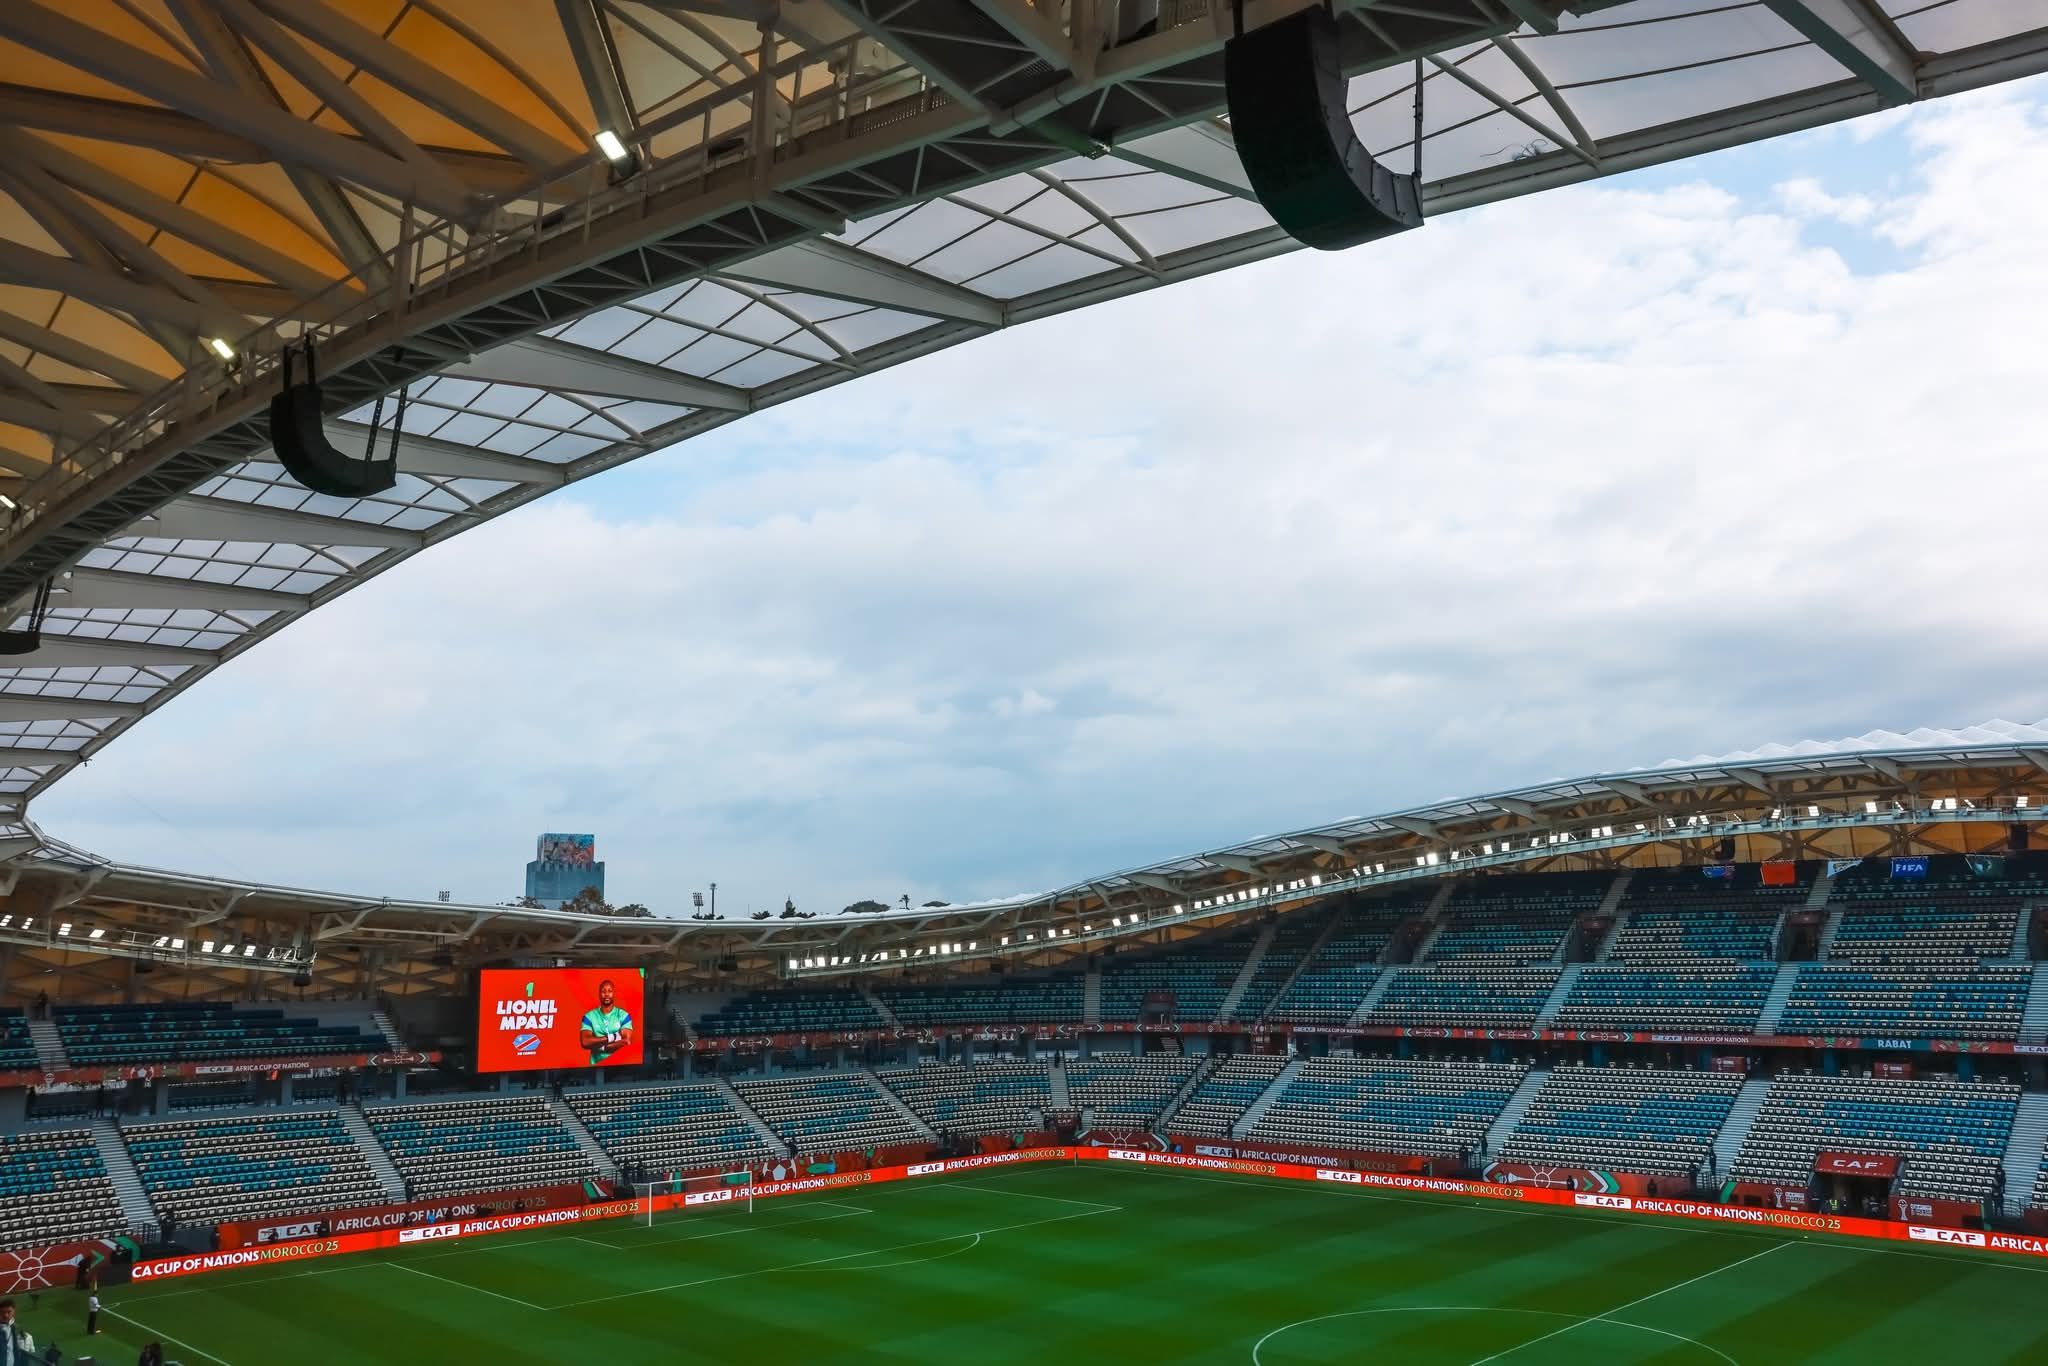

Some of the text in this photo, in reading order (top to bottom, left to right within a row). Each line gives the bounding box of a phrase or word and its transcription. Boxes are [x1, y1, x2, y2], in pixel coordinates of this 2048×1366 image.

[1896, 864, 1924, 872] FIFA
[526, 982, 535, 997] 1
[496, 1000, 558, 1014] LIONEL
[500, 1015, 554, 1030] MPASI
[1878, 1040, 1912, 1048] RABAT
[921, 1164, 940, 1173] CAF
[946, 1158, 970, 1170] AFRICA
[970, 1158, 982, 1167] CUP
[983, 1156, 992, 1165] OF
[992, 1152, 1019, 1164] NATIONS
[1019, 1150, 1056, 1160] MOROCCO
[1123, 1152, 1142, 1160] CAF
[1148, 1153, 1172, 1164] AFRICA
[1173, 1156, 1186, 1165] CUP
[1187, 1158, 1197, 1166] OF
[1197, 1158, 1228, 1169] NATIONS
[1228, 1162, 1267, 1173] MOROCCO
[1242, 1150, 1270, 1160] AFRICA
[1271, 1152, 1288, 1162] CUP
[1289, 1154, 1300, 1162] OF
[1301, 1156, 1338, 1167] NATIONS
[1832, 1160, 1878, 1168] CAF
[703, 1192, 726, 1201] CAF
[764, 1185, 780, 1194] CUP
[781, 1183, 791, 1192] OF
[792, 1178, 824, 1190] NATIONS
[825, 1174, 862, 1185] MOROCCO
[862, 1172, 871, 1182] 25
[1333, 1172, 1524, 1198] CAF AFRICA CUP OF NATIONS MOROCCO 25
[422, 1226, 454, 1238] CAF
[463, 1217, 500, 1233] AFRICA
[502, 1216, 522, 1228] CUP
[523, 1214, 536, 1226] OF
[538, 1210, 579, 1224] NATIONS
[580, 1204, 628, 1218] MOROCCO
[630, 1202, 639, 1211] 25
[1596, 1197, 1625, 1207] CAF
[1635, 1200, 1673, 1212] AFRICA
[1675, 1204, 1696, 1215] CUP
[1697, 1206, 1713, 1216] OF
[1714, 1207, 1763, 1222] NATIONS
[1764, 1212, 1826, 1228] MOROCCO
[1828, 1219, 1841, 1229] 25
[336, 1216, 380, 1231] AFRICA
[1937, 1232, 1977, 1243] CAF
[1991, 1236, 2044, 1252] AFRICA
[132, 1240, 339, 1278] CA CUP OF NATIONS MOROCCO 25
